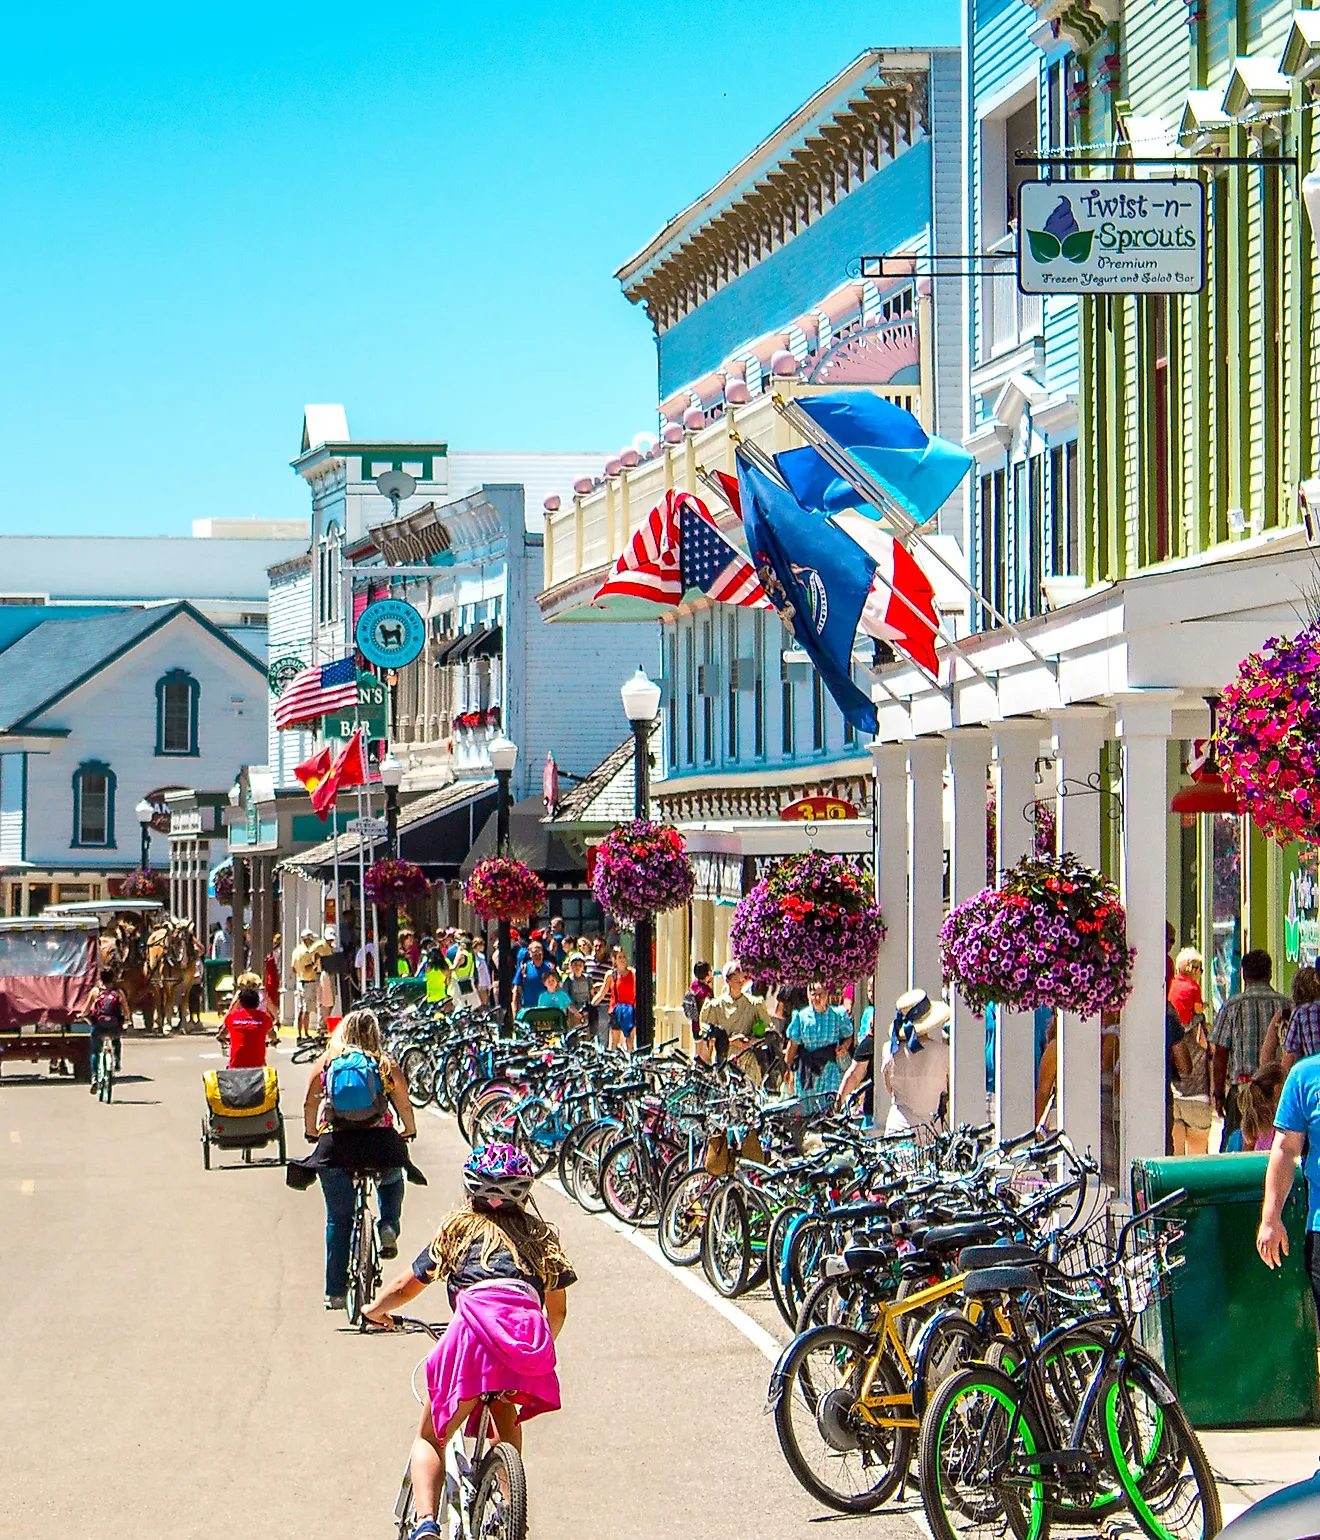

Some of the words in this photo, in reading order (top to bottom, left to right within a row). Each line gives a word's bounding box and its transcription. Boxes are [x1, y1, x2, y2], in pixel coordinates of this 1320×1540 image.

[1080, 188, 1149, 219] Twist
[1152, 199, 1192, 218] -n-
[1097, 222, 1197, 255] Sprouts
[1097, 255, 1158, 269] Premium
[1041, 273, 1079, 284] Frozen
[1080, 273, 1118, 287] Yogurt
[1119, 273, 1140, 284] and
[1141, 272, 1172, 284] Salad
[1174, 271, 1195, 283] Bar
[270, 659, 305, 677] STARBUC
[340, 720, 372, 737] BAR
